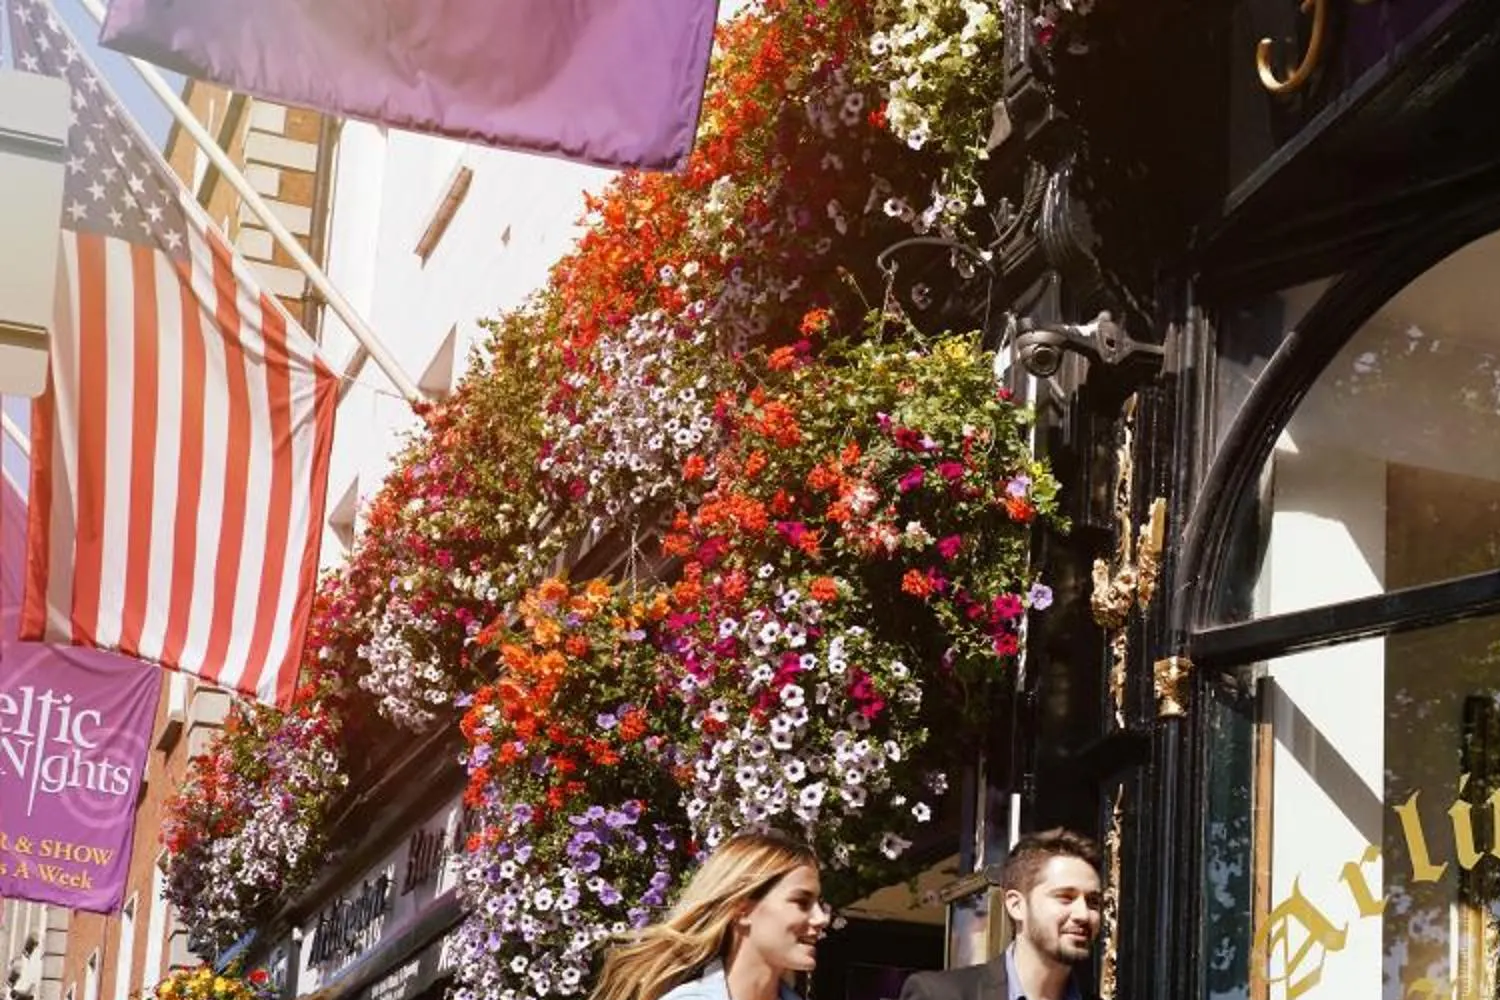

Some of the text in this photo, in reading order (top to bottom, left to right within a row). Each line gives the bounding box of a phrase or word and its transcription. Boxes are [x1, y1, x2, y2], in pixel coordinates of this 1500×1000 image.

[0, 686, 102, 752] eltic
[15, 836, 32, 854] &
[39, 839, 113, 866] SHOW
[11, 861, 29, 879] A
[38, 863, 94, 889] Week
